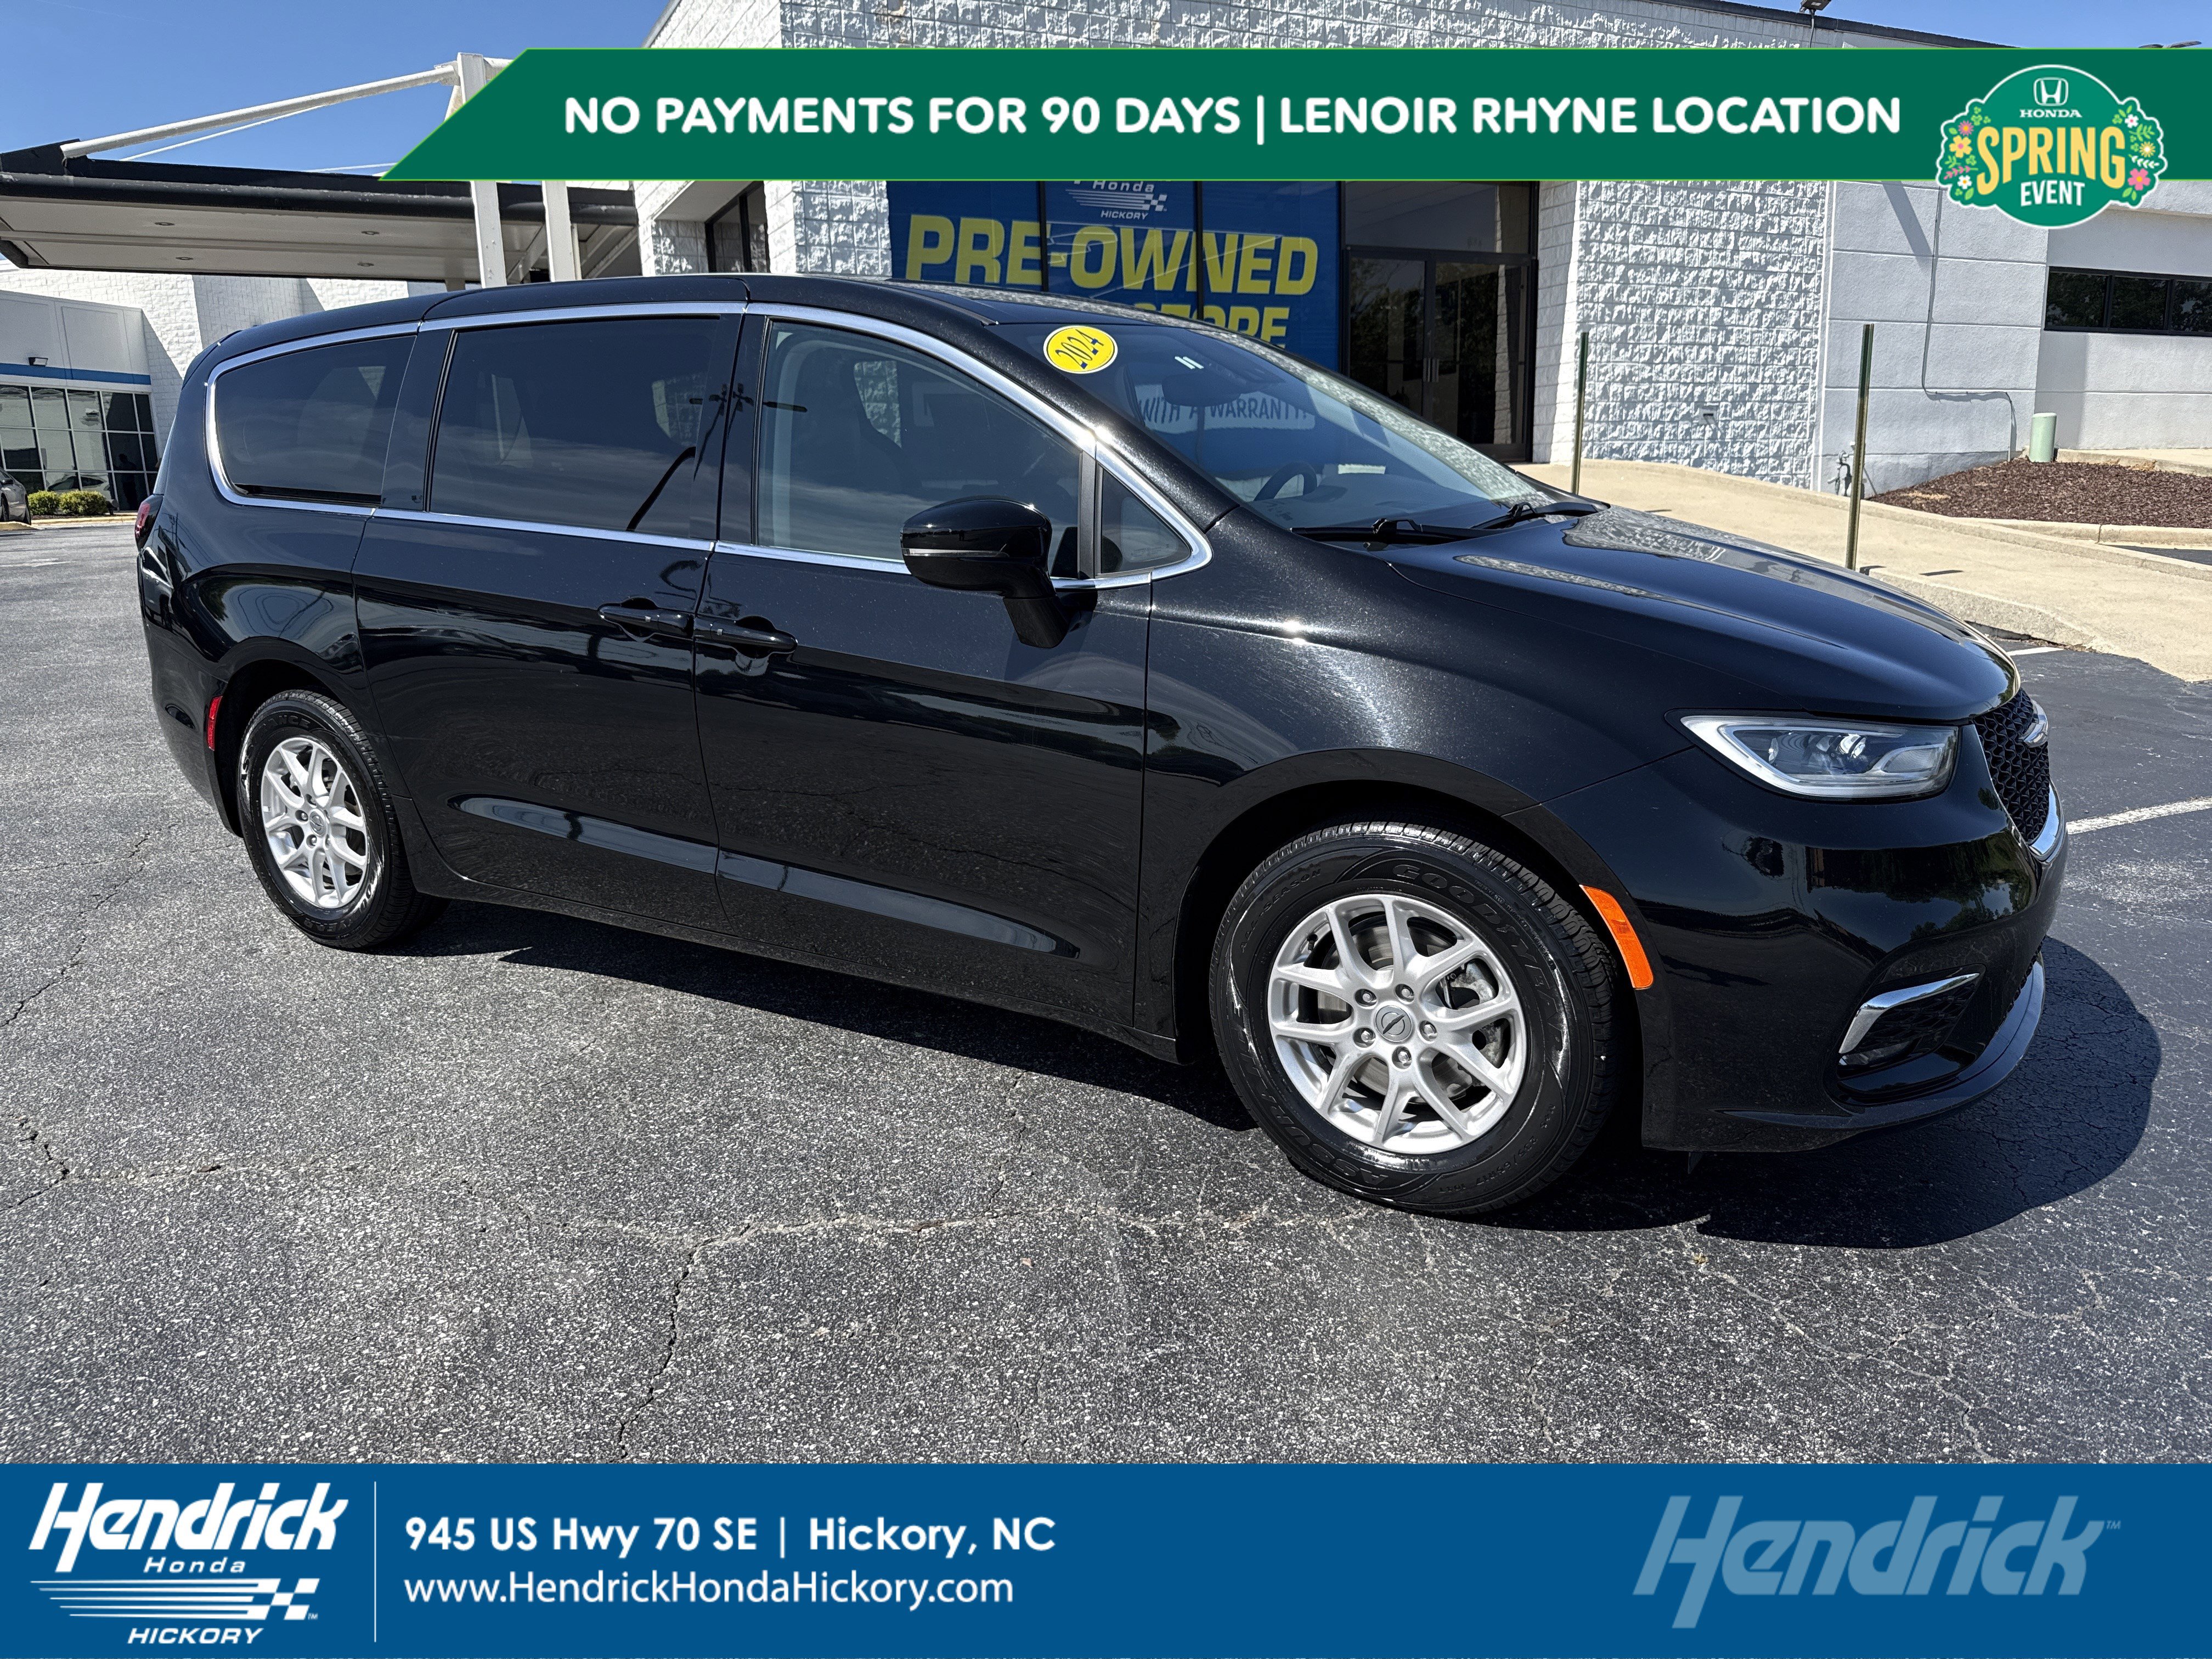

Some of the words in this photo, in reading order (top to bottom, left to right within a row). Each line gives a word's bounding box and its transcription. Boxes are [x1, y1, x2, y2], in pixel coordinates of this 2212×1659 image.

[1092, 180, 1155, 192] Honda
[1101, 210, 1149, 220] HICKORY
[906, 214, 1318, 296] PRE-OWNED
[1055, 329, 1104, 369] 2024
